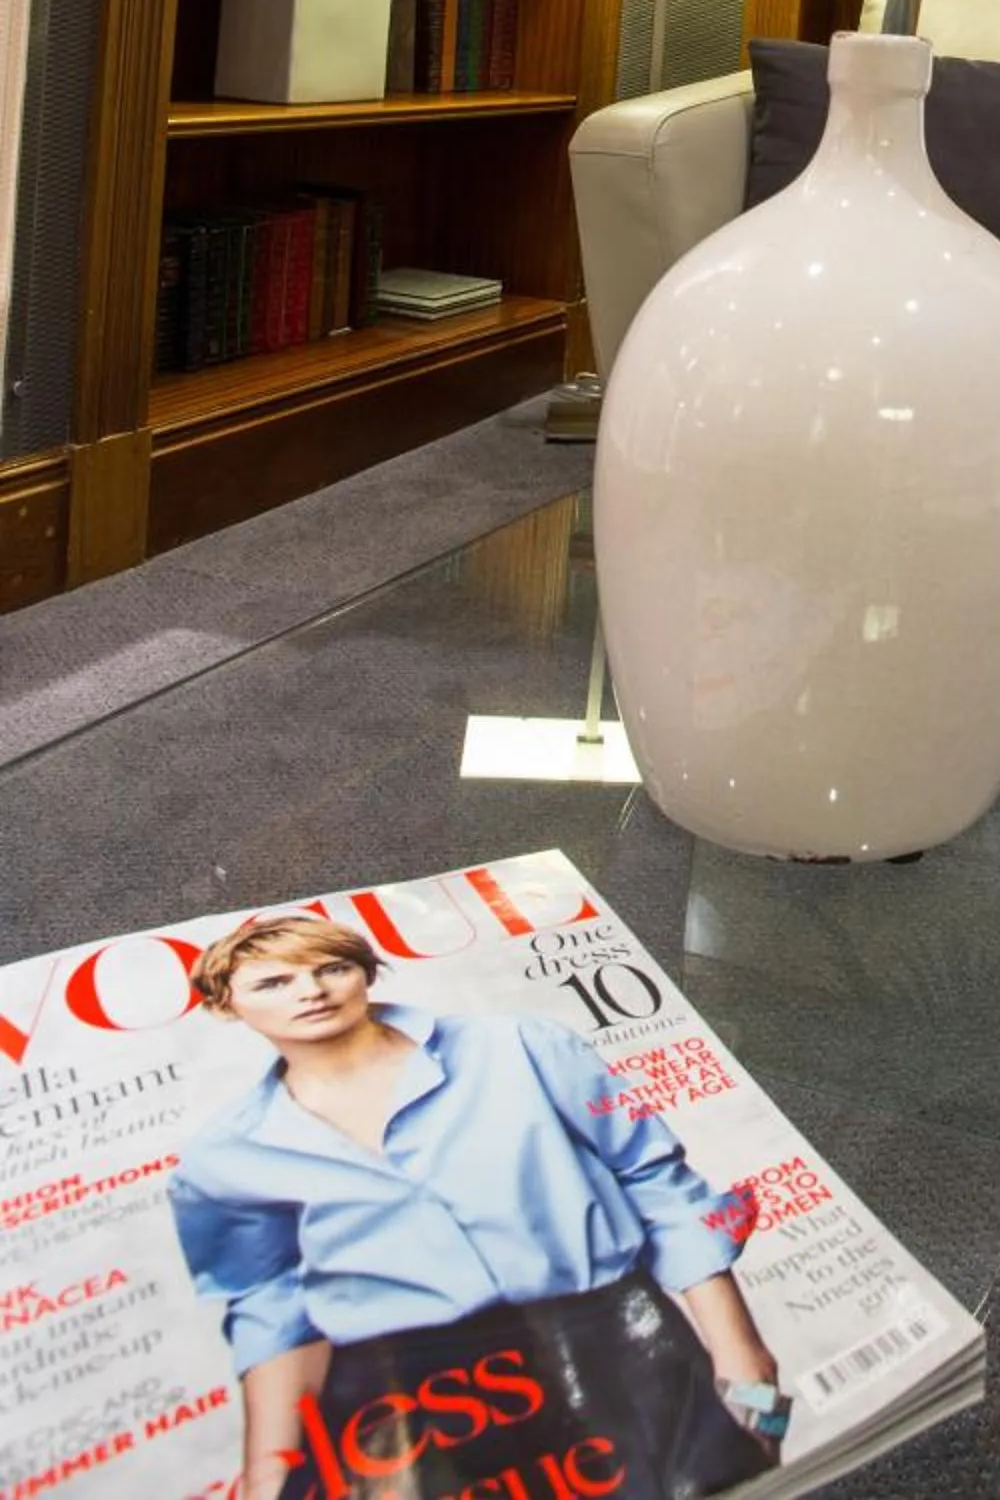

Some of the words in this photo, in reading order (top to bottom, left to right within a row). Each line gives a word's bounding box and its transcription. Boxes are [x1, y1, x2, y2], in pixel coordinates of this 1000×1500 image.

[530, 925, 612, 951] One
[0, 866, 600, 1066] VOUE
[525, 943, 632, 980] dress
[559, 963, 663, 1031] 10
[582, 1015, 687, 1049] solutions
[608, 1048, 668, 1076] HOW
[671, 1037, 705, 1056] TO
[644, 1050, 720, 1080] WEAR
[587, 1073, 692, 1117] LEATHER
[699, 1061, 728, 1081] AT
[628, 1093, 679, 1122] ANY
[687, 1077, 738, 1103] AGE
[730, 1156, 807, 1193] FROM
[782, 1171, 818, 1194] TO
[728, 1185, 833, 1244] WOMEN
[778, 1204, 849, 1243] What
[741, 1218, 863, 1290] happened
[805, 1263, 835, 1286] to
[837, 1237, 880, 1271] the
[784, 1256, 896, 1318] Nineties
[145, 1386, 230, 1438] HAIR
